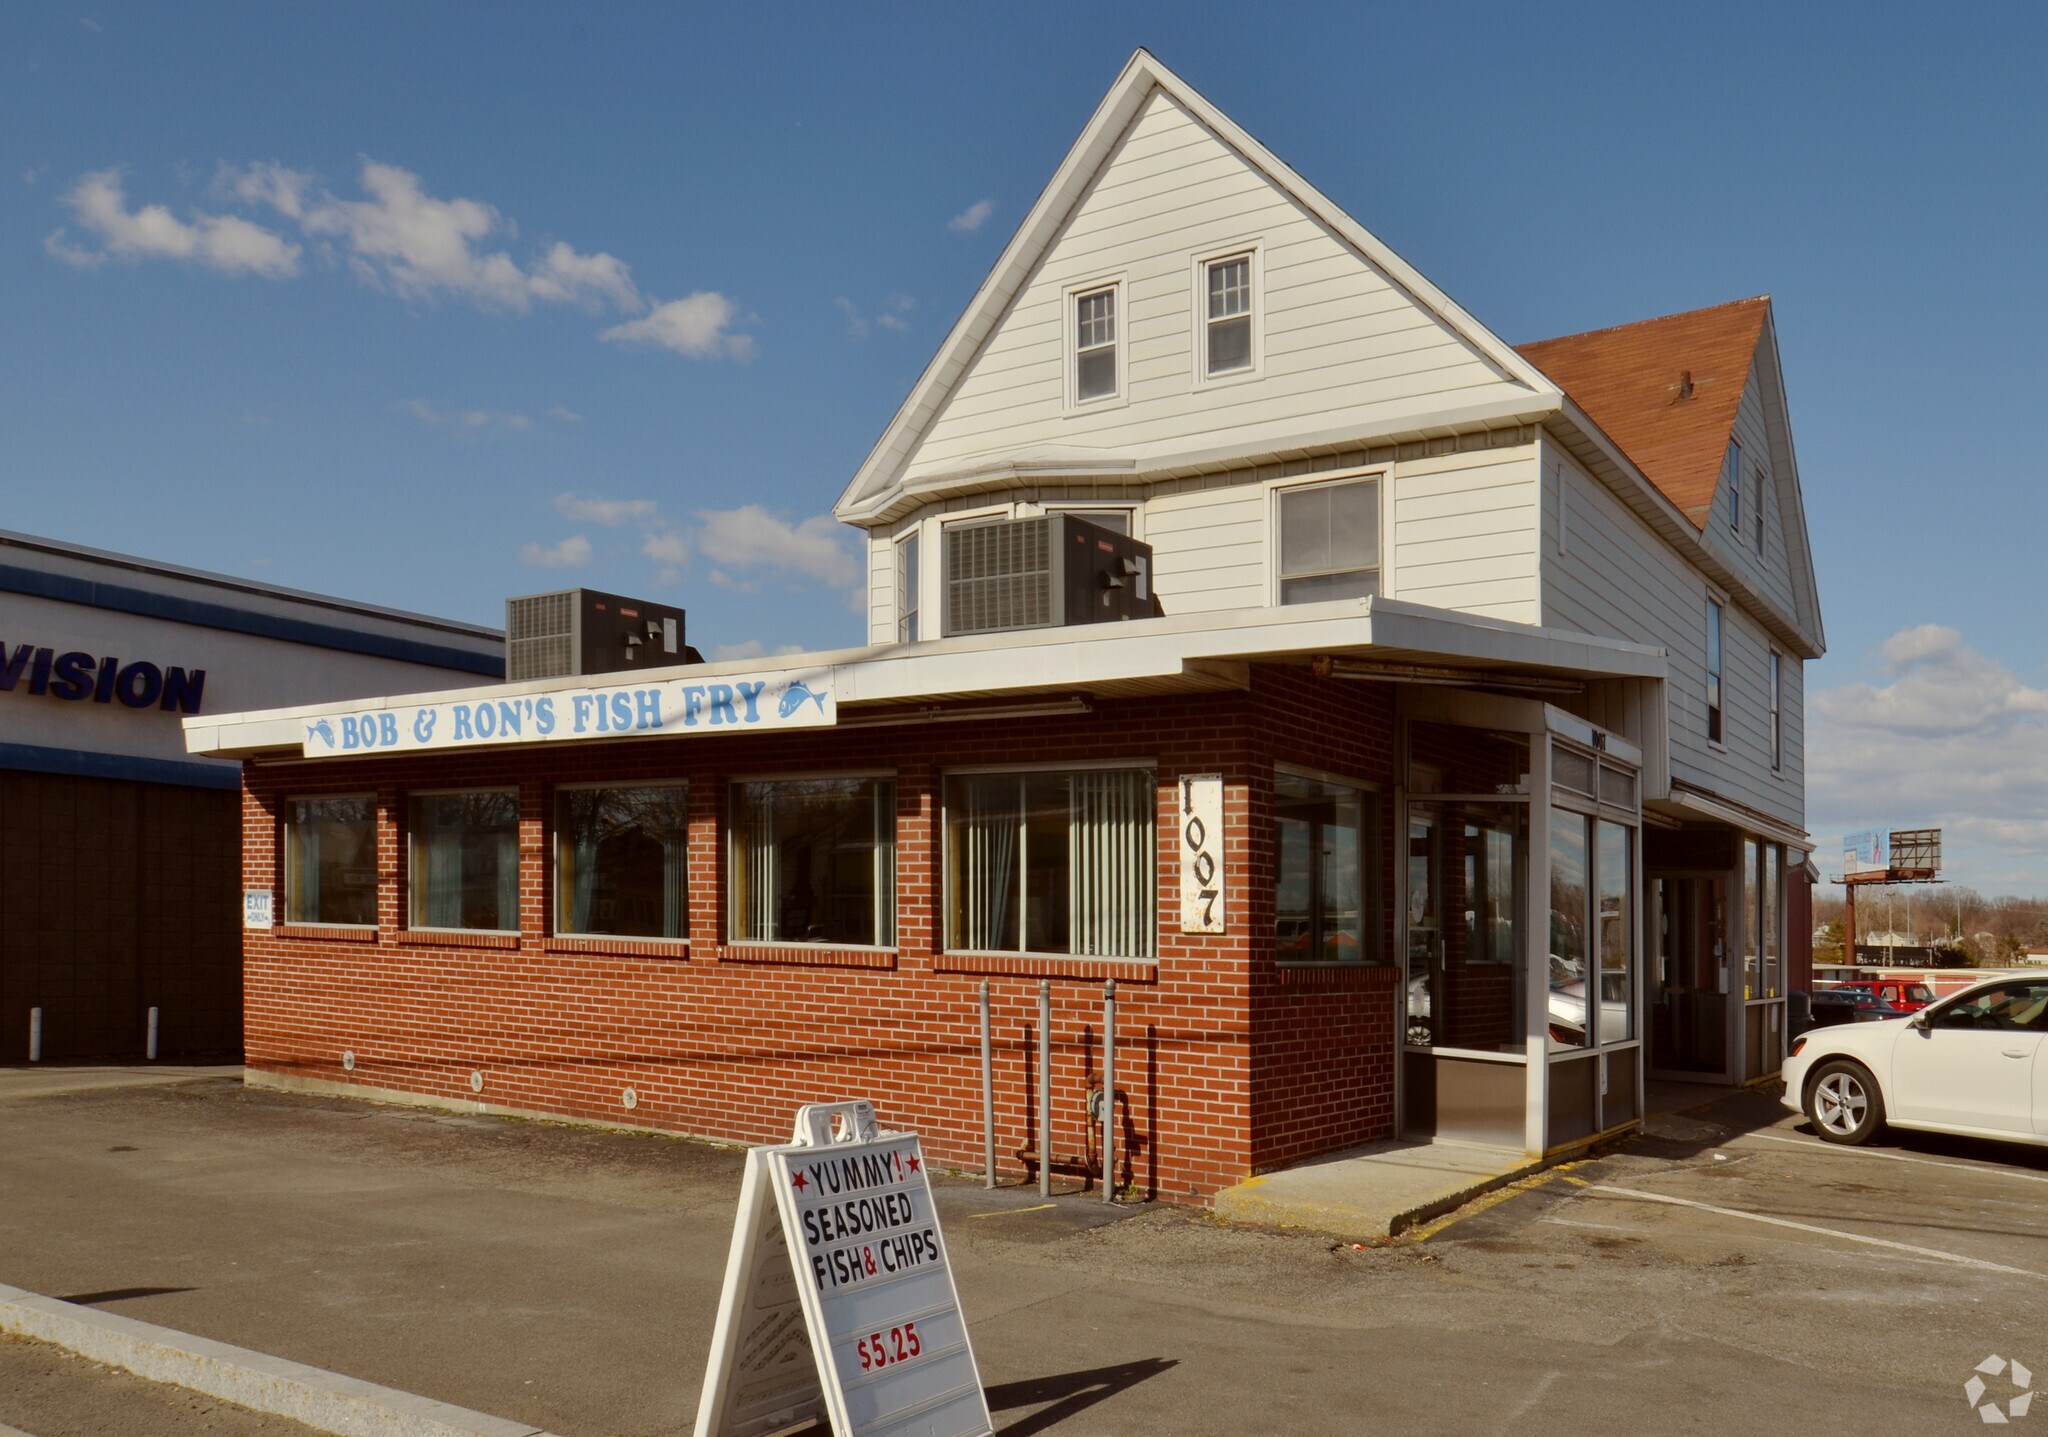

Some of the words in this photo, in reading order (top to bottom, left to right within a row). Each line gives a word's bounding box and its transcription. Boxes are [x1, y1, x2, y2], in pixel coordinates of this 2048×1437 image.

[0, 641, 206, 714] VISION
[341, 712, 398, 749] BOB
[413, 708, 437, 743] &
[452, 697, 555, 741] RON'S
[572, 689, 664, 733] FISH
[682, 680, 766, 726] FRY
[1183, 779, 1219, 927] 1007
[247, 894, 269, 910] EXIT
[809, 1150, 904, 1196] YUMMY!
[803, 1192, 912, 1245] SEASONED
[880, 1229, 938, 1273] CHIPS
[857, 1322, 920, 1372] $5.25
